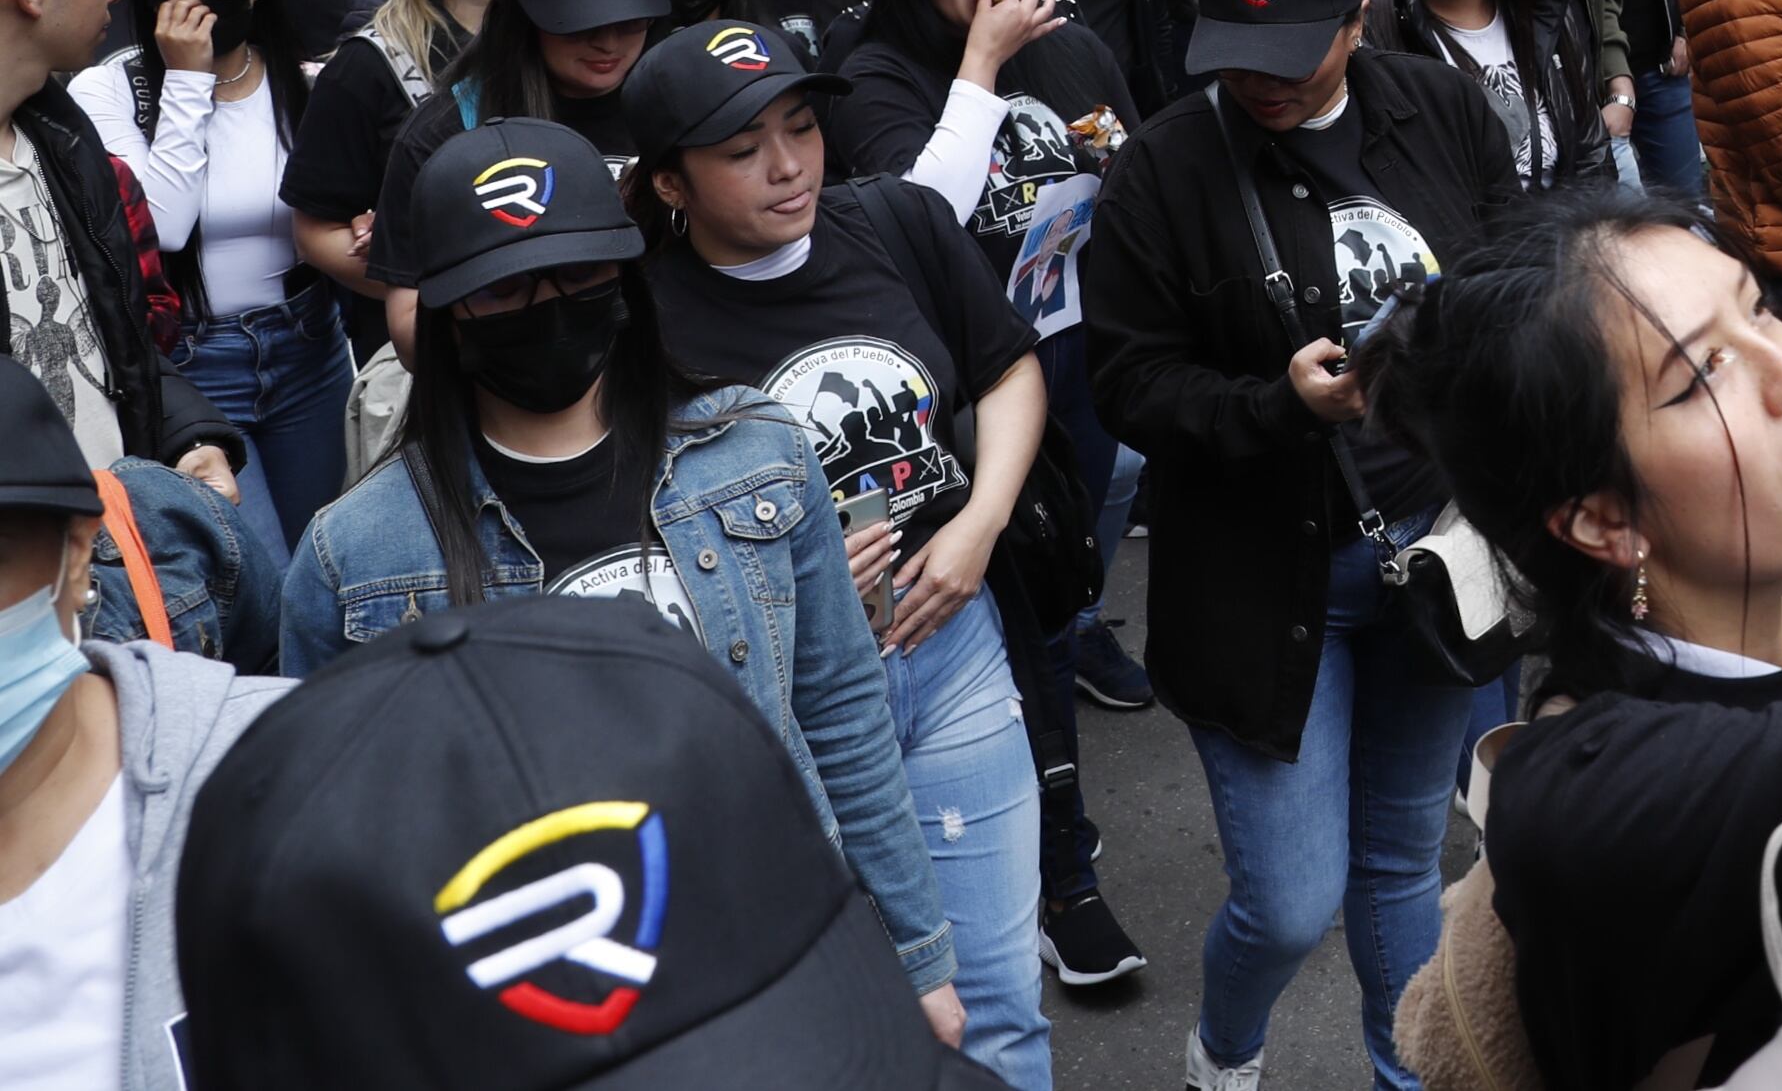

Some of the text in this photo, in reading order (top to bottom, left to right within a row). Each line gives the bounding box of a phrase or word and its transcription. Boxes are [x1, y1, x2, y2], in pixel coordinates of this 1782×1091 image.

[791, 355, 829, 380] Activa
[830, 348, 849, 361] del
[853, 347, 895, 367] Pueblo
[580, 565, 630, 593] Activa
